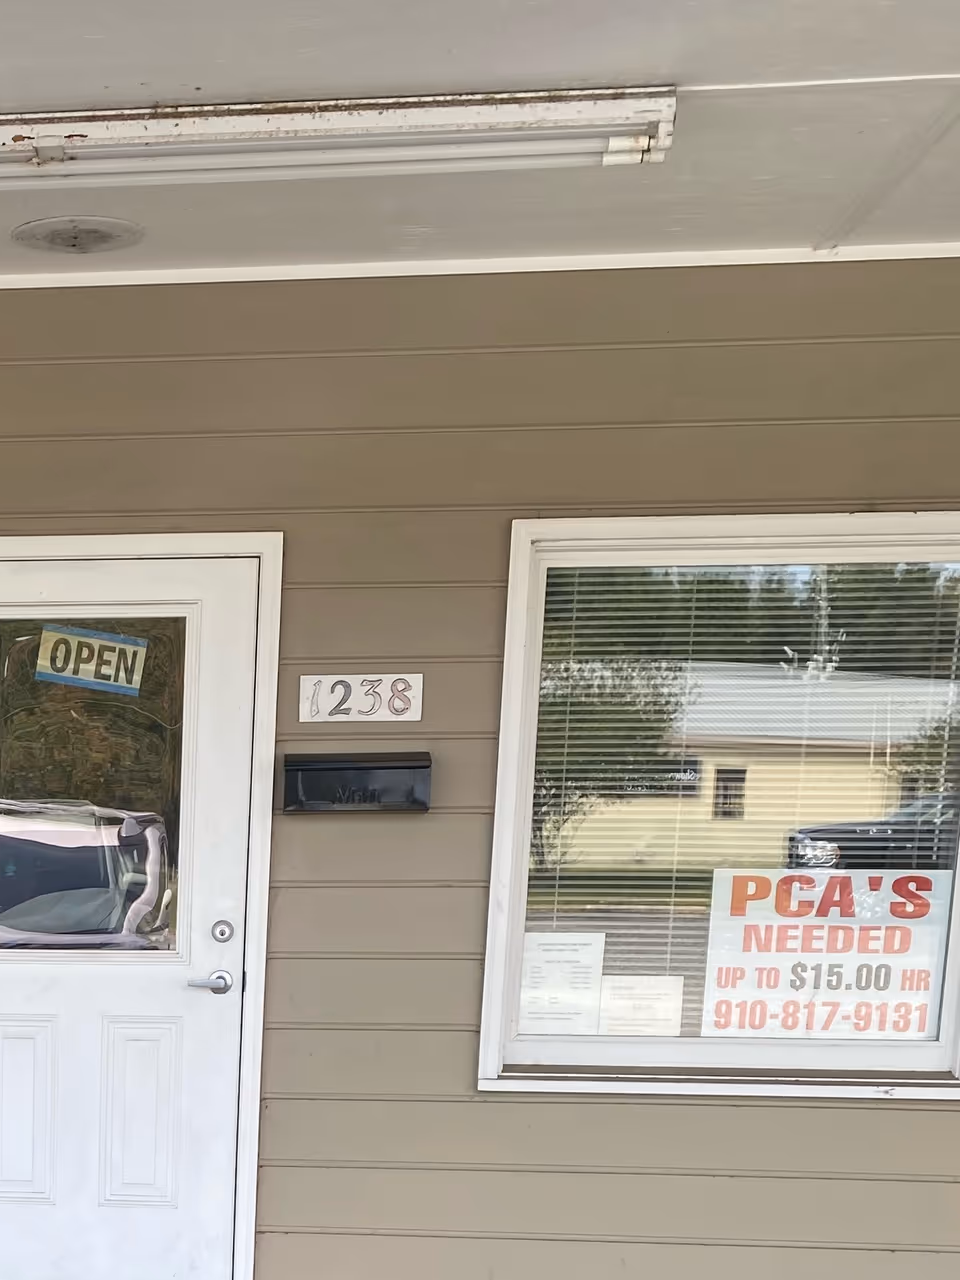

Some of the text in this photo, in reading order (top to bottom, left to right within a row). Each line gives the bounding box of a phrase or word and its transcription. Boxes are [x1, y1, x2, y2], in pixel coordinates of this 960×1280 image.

[49, 636, 139, 686] OPEN
[310, 678, 414, 719] 1238
[729, 874, 933, 919] PCA'S
[741, 924, 912, 954] NEEDED
[717, 962, 931, 991] UP TO $15.00 HR
[713, 999, 930, 1033] 910-817-9131
